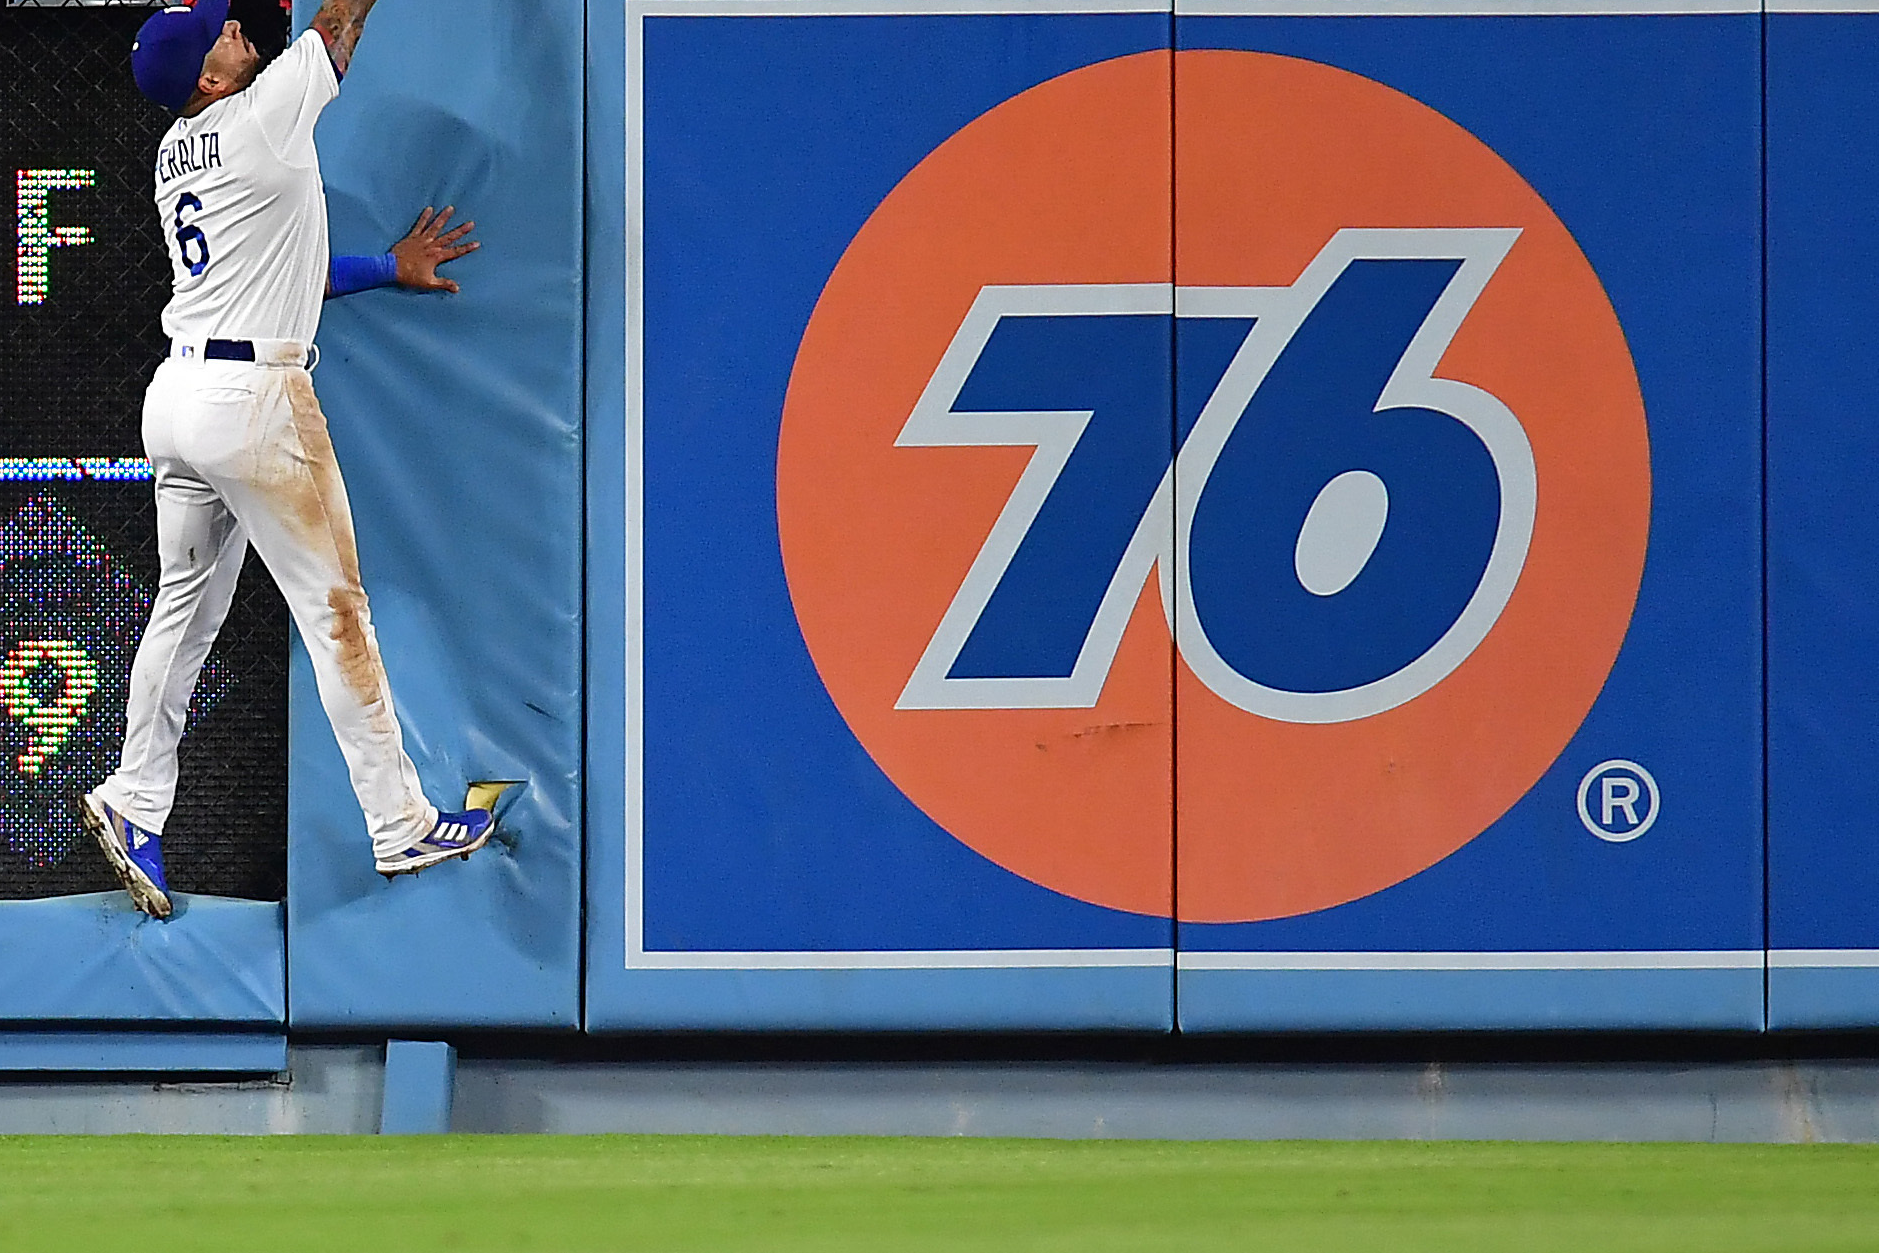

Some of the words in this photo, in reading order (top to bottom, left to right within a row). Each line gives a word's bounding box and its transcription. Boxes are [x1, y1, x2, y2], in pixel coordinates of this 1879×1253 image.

[17, 168, 95, 305] F
[175, 192, 210, 276] 6
[894, 227, 1538, 725] 76
